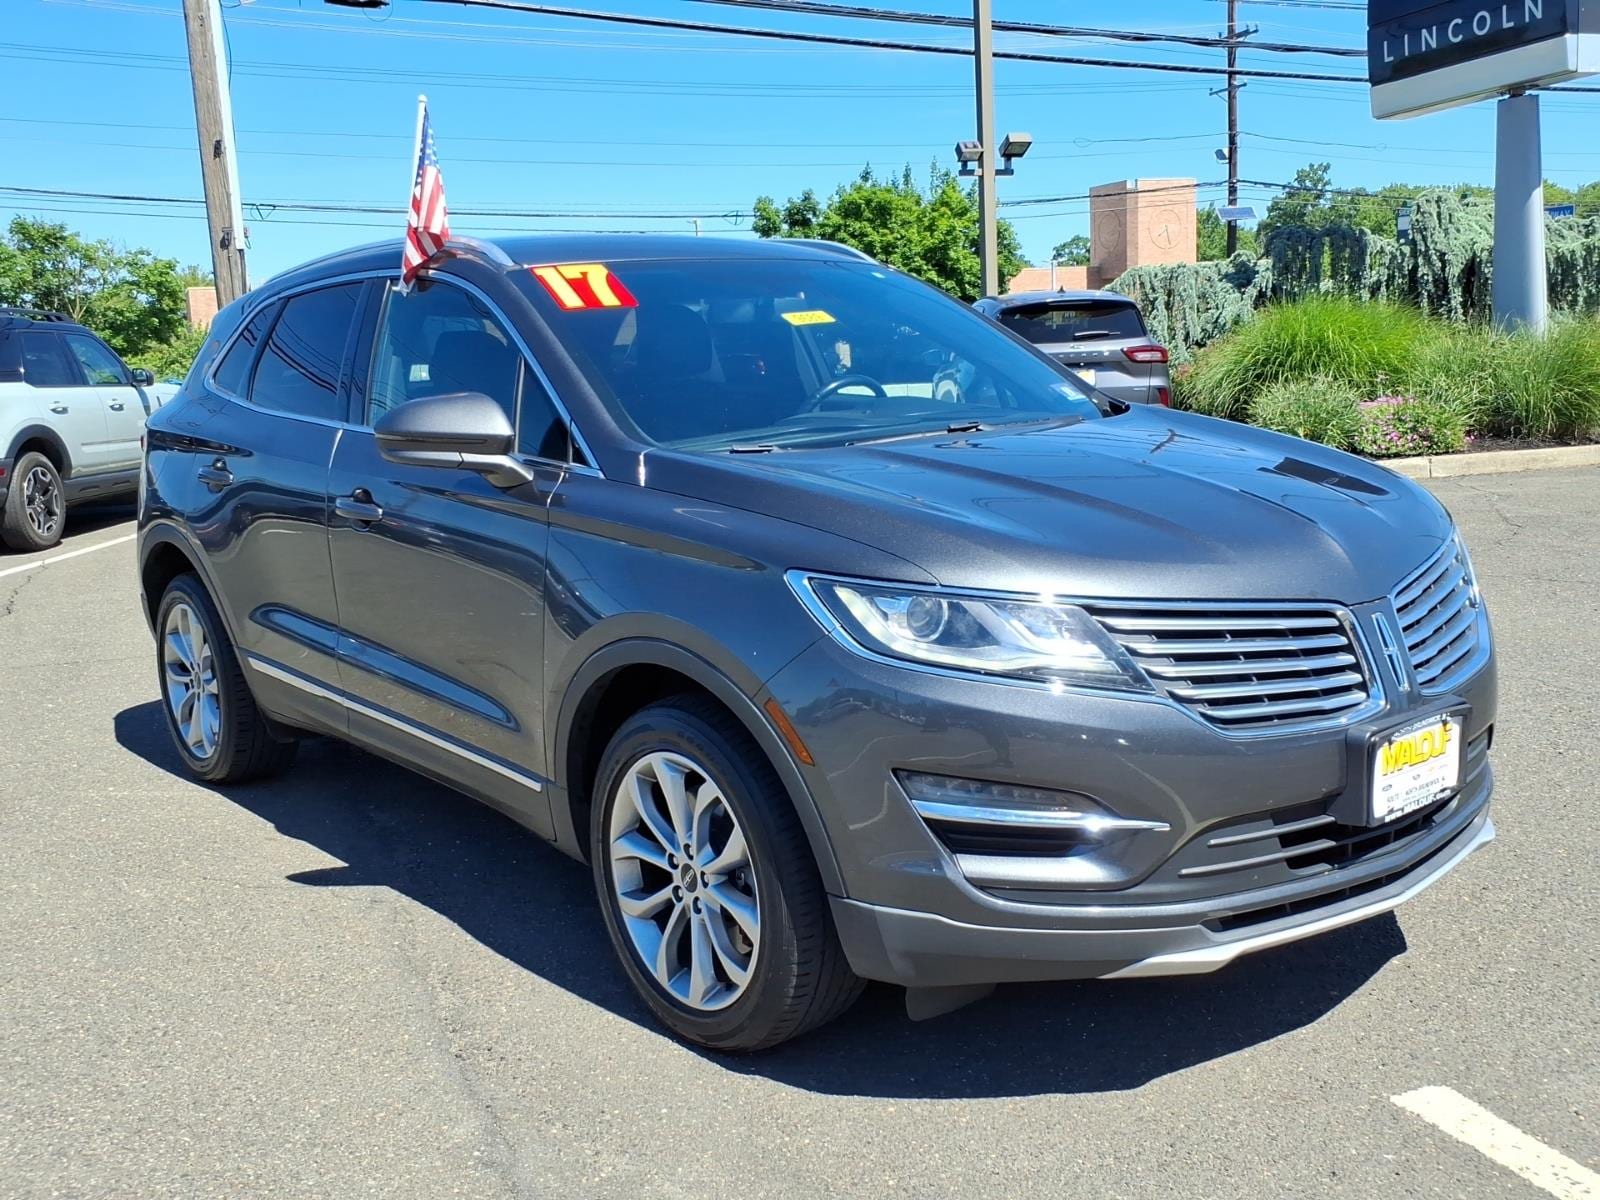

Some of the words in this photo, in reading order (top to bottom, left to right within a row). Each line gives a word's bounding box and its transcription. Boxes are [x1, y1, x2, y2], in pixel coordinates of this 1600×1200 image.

[1383, 0, 1543, 62] LINCOLN
[532, 264, 622, 308] 17
[1381, 723, 1453, 776] MALOUF
